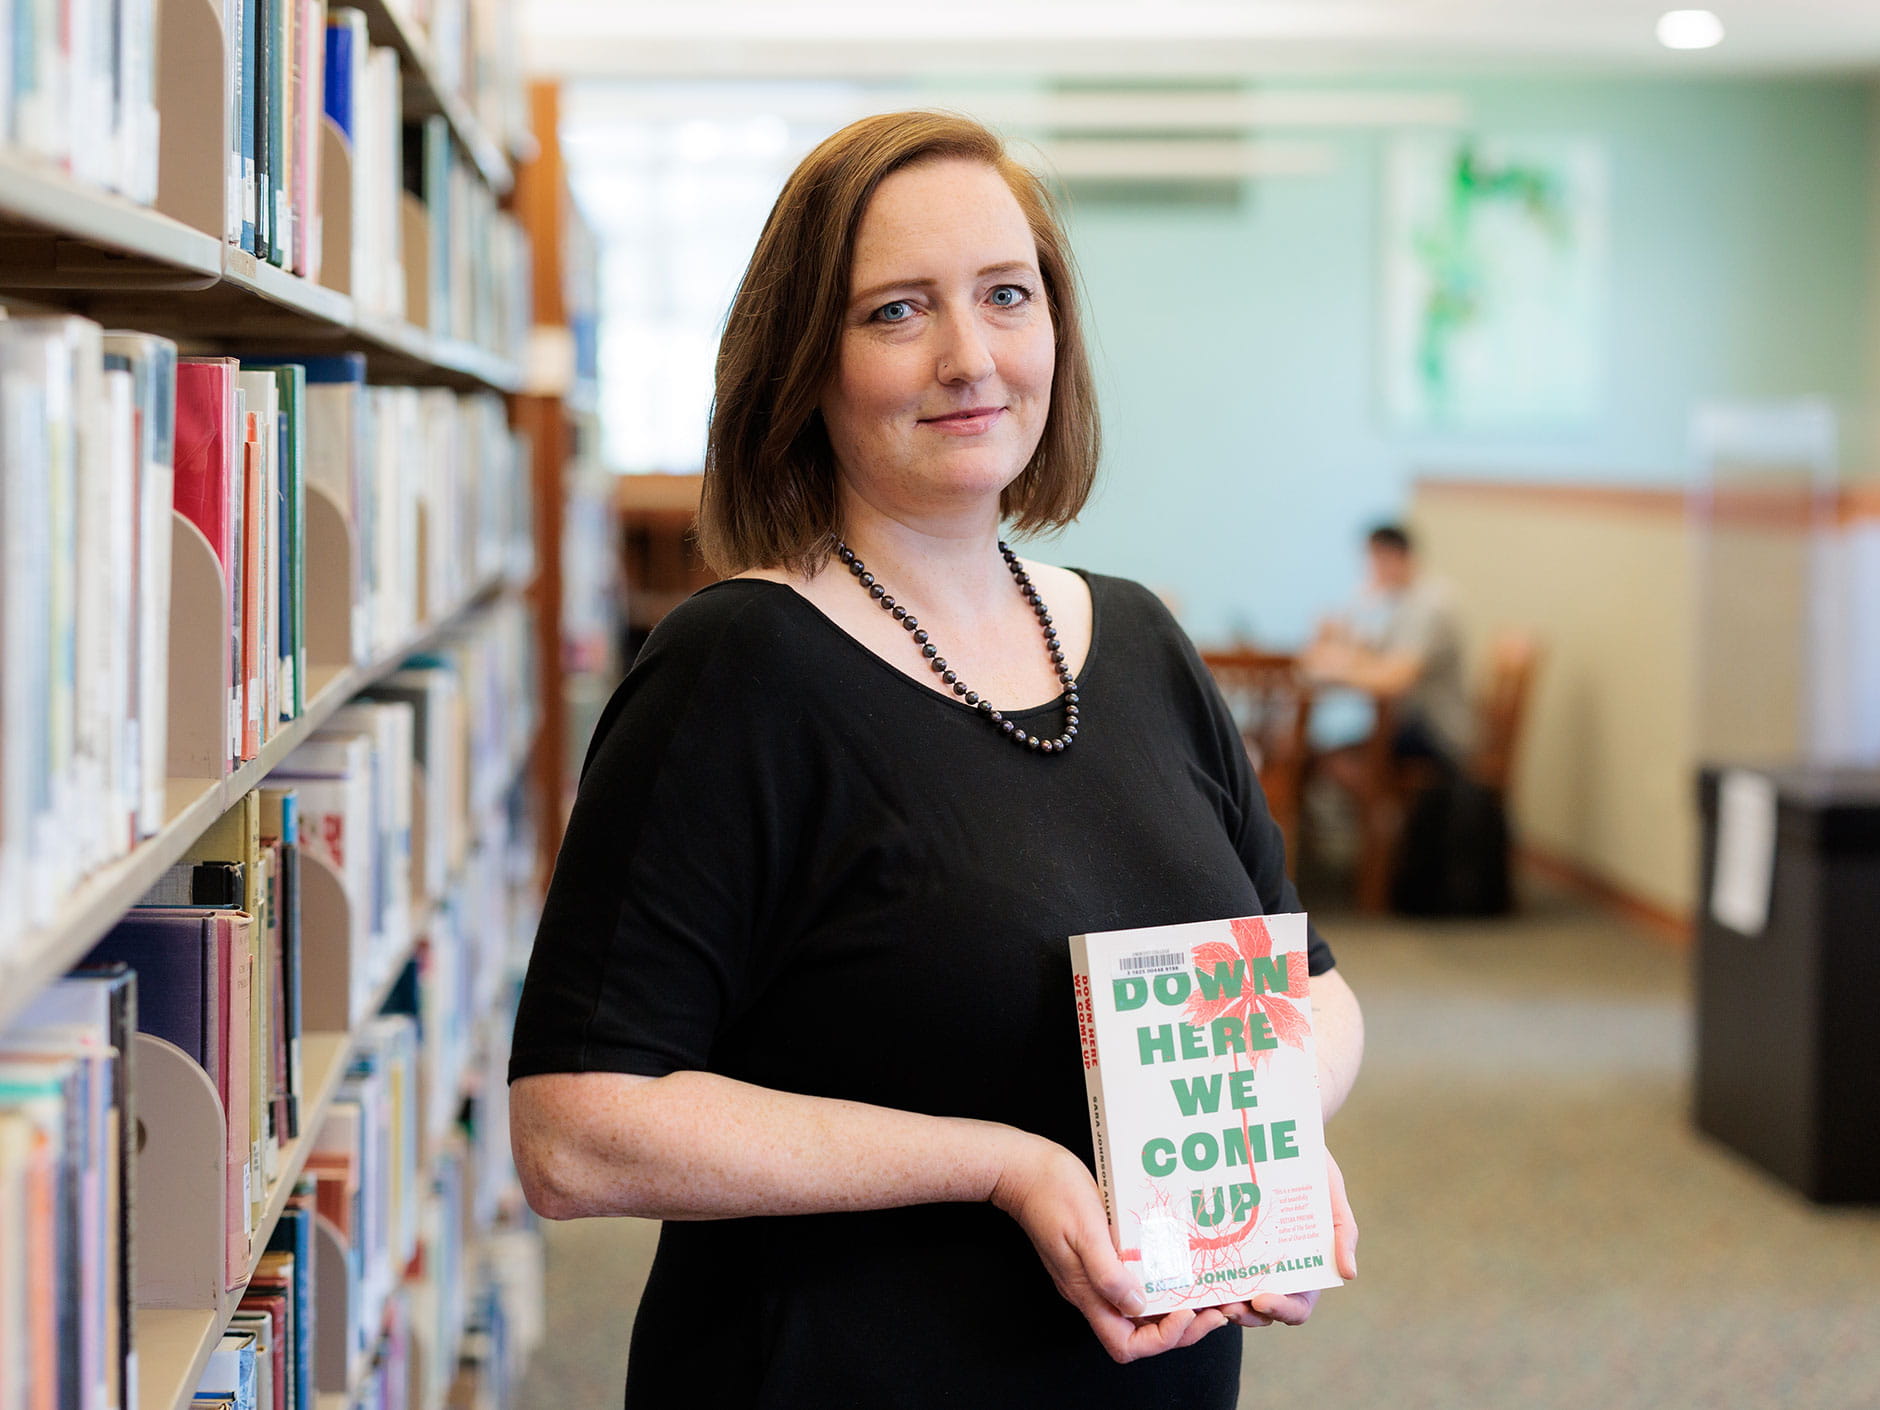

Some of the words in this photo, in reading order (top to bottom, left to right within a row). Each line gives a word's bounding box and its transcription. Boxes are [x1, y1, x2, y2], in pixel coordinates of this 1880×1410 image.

[1074, 974, 1082, 997] WE
[1112, 955, 1289, 1012] DOWN
[1077, 1002, 1088, 1045] COME
[1082, 976, 1092, 1023] DOWN
[1088, 1028, 1098, 1066] HERE
[1137, 1012, 1279, 1065] HERE
[1083, 1050, 1091, 1070] UP
[1170, 1069, 1258, 1117] WE
[1141, 1119, 1300, 1178] COME
[1097, 1130, 1108, 1187] JOHNSON
[1103, 1190, 1113, 1226] ALLEN
[1190, 1182, 1262, 1228] UP
[1195, 1262, 1271, 1286] JOHNSON
[1276, 1255, 1324, 1273] ALLEN
